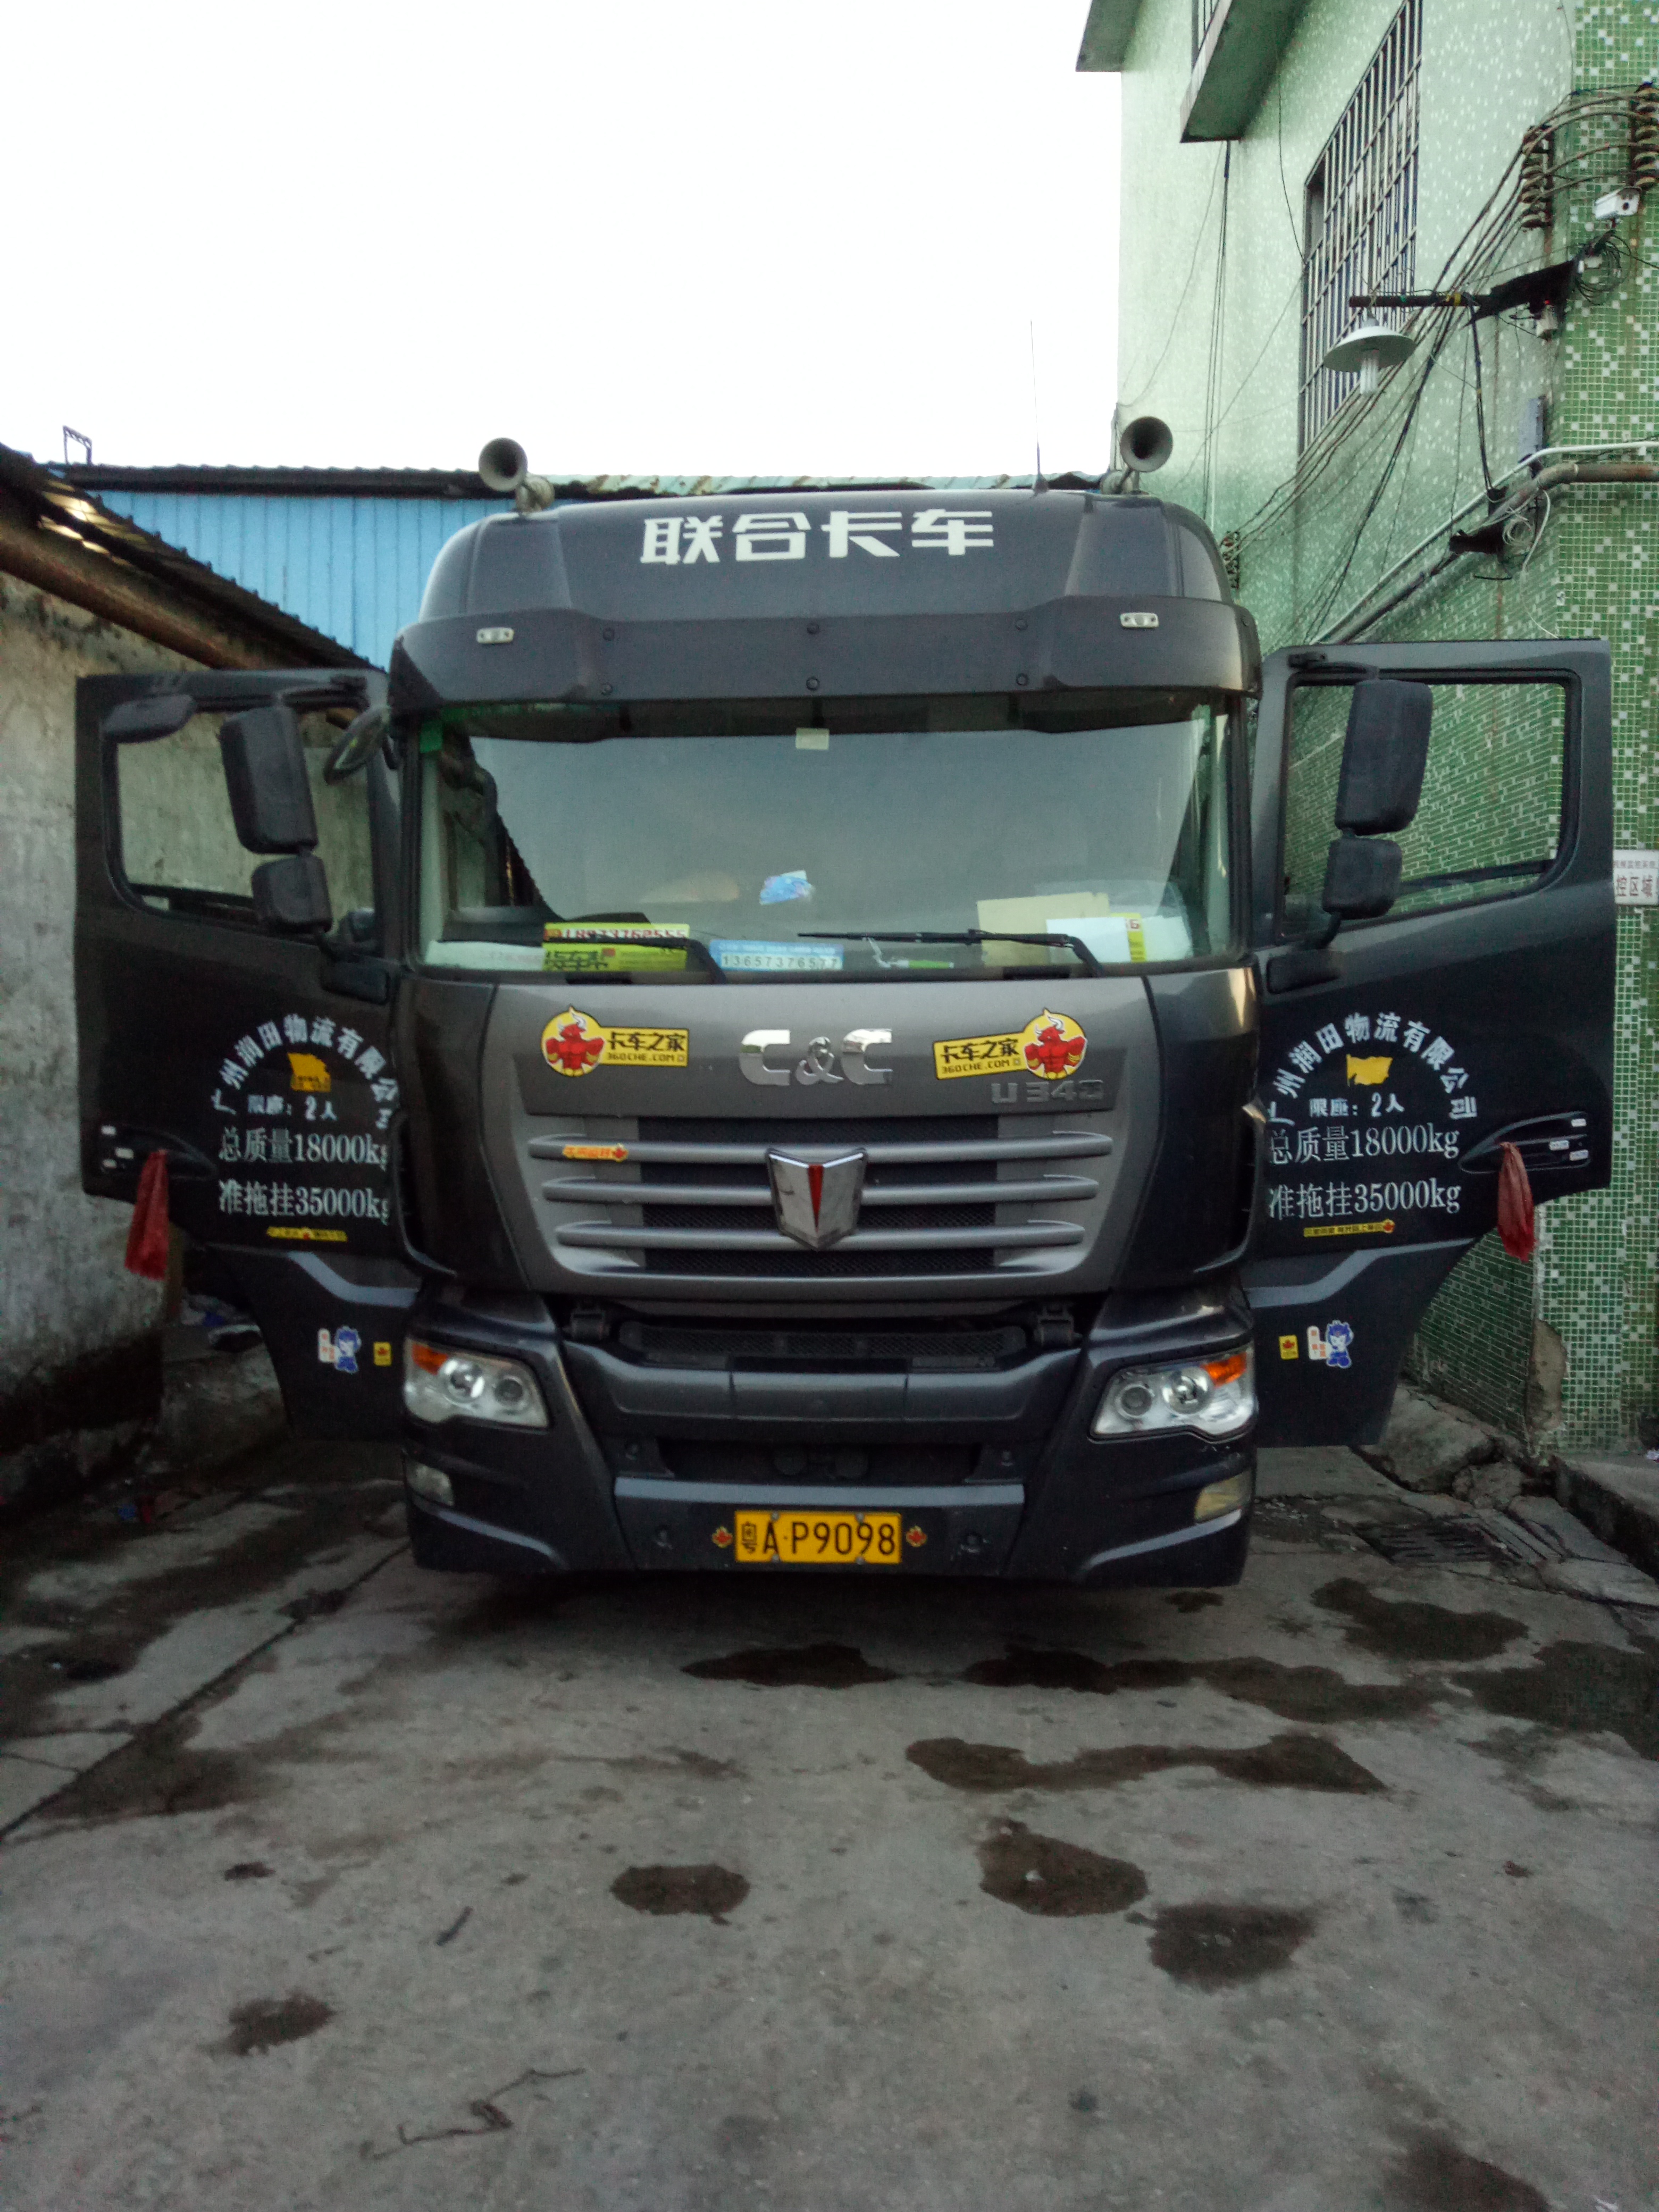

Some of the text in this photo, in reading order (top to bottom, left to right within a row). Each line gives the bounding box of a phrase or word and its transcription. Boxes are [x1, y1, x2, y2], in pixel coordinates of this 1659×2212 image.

[640, 508, 994, 565] 联合卡车
[607, 1032, 686, 1051] 卡车之家
[740, 1029, 893, 1086] C&C
[941, 1038, 1021, 1063] 卡车之家
[942, 1060, 1010, 1074] 360CHE.COM
[1267, 1012, 1478, 1126] 广州润田物流有限公司
[219, 1127, 388, 1171] 总质量18000kg
[1270, 1122, 1460, 1164] 总质量18000kg
[219, 1179, 389, 1225] 准拖挂35000kg
[1269, 1178, 1461, 1220] 准拖挂35000kg
